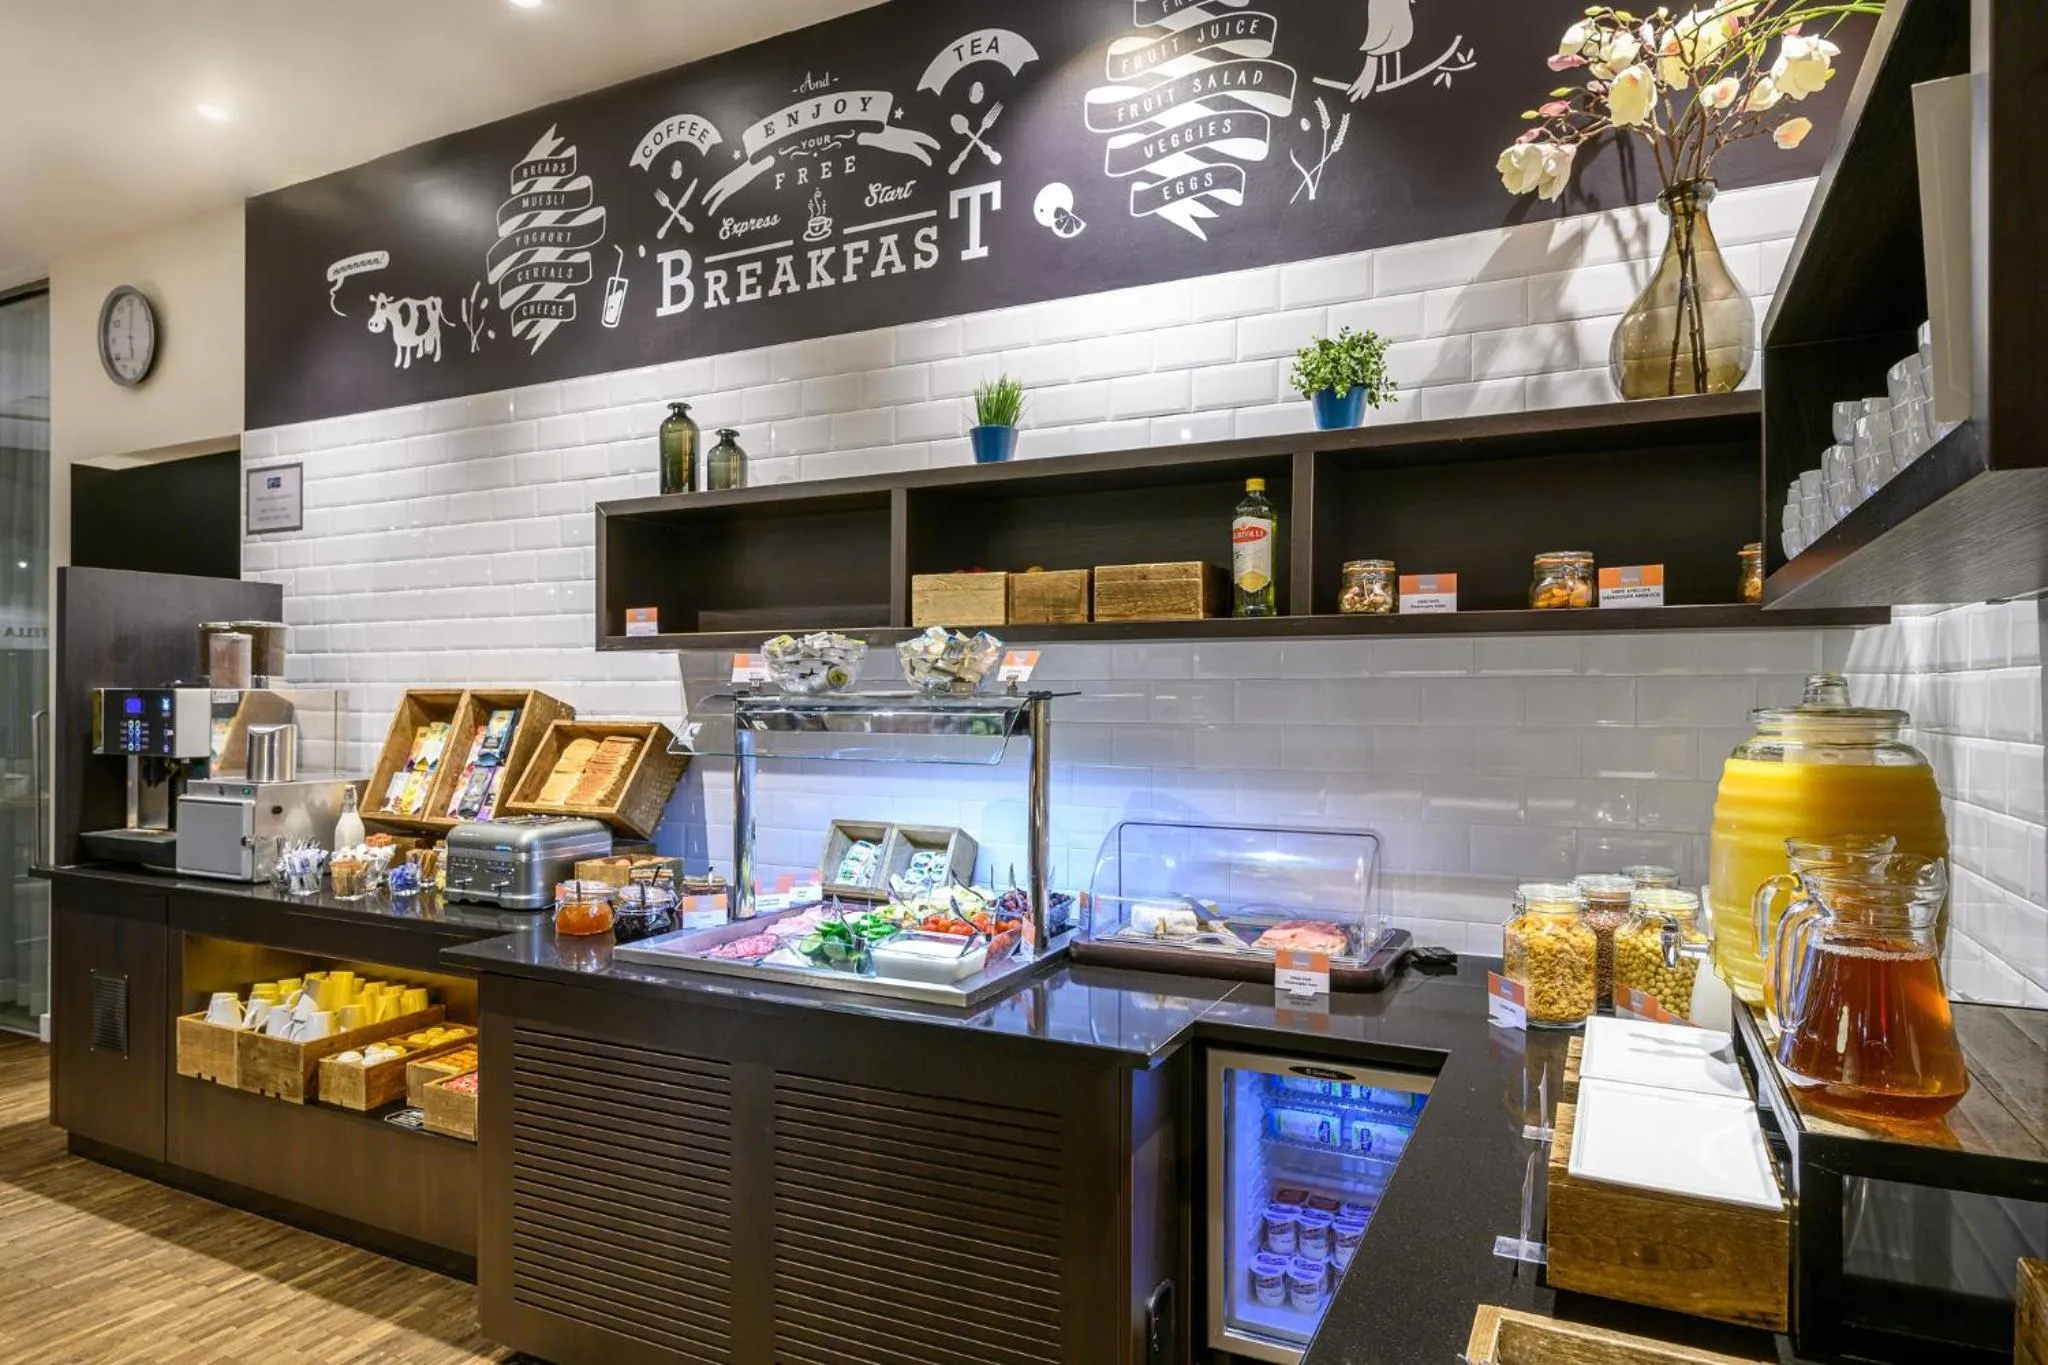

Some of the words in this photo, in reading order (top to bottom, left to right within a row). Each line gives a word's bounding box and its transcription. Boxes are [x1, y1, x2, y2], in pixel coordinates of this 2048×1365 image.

[952, 35, 1001, 63] TEA
[1121, 37, 1180, 74] FRUIT
[1196, 19, 1260, 43] JUICE
[1117, 87, 1176, 122] FRUIT
[1192, 69, 1264, 93] SALAD
[763, 96, 873, 139] ENJOY
[642, 120, 710, 159] COFFEE
[800, 134, 831, 149] YOUR
[1143, 118, 1232, 159] VEGGIES
[522, 162, 566, 178] BREADS
[774, 155, 857, 191] FREE
[1162, 172, 1214, 201] EGGS
[522, 194, 565, 209] MUESLI
[719, 214, 781, 240] Express
[864, 180, 917, 207] Start
[515, 231, 572, 247] YOGHURT
[517, 266, 573, 282] CEREALS
[522, 303, 563, 317] CHEESE
